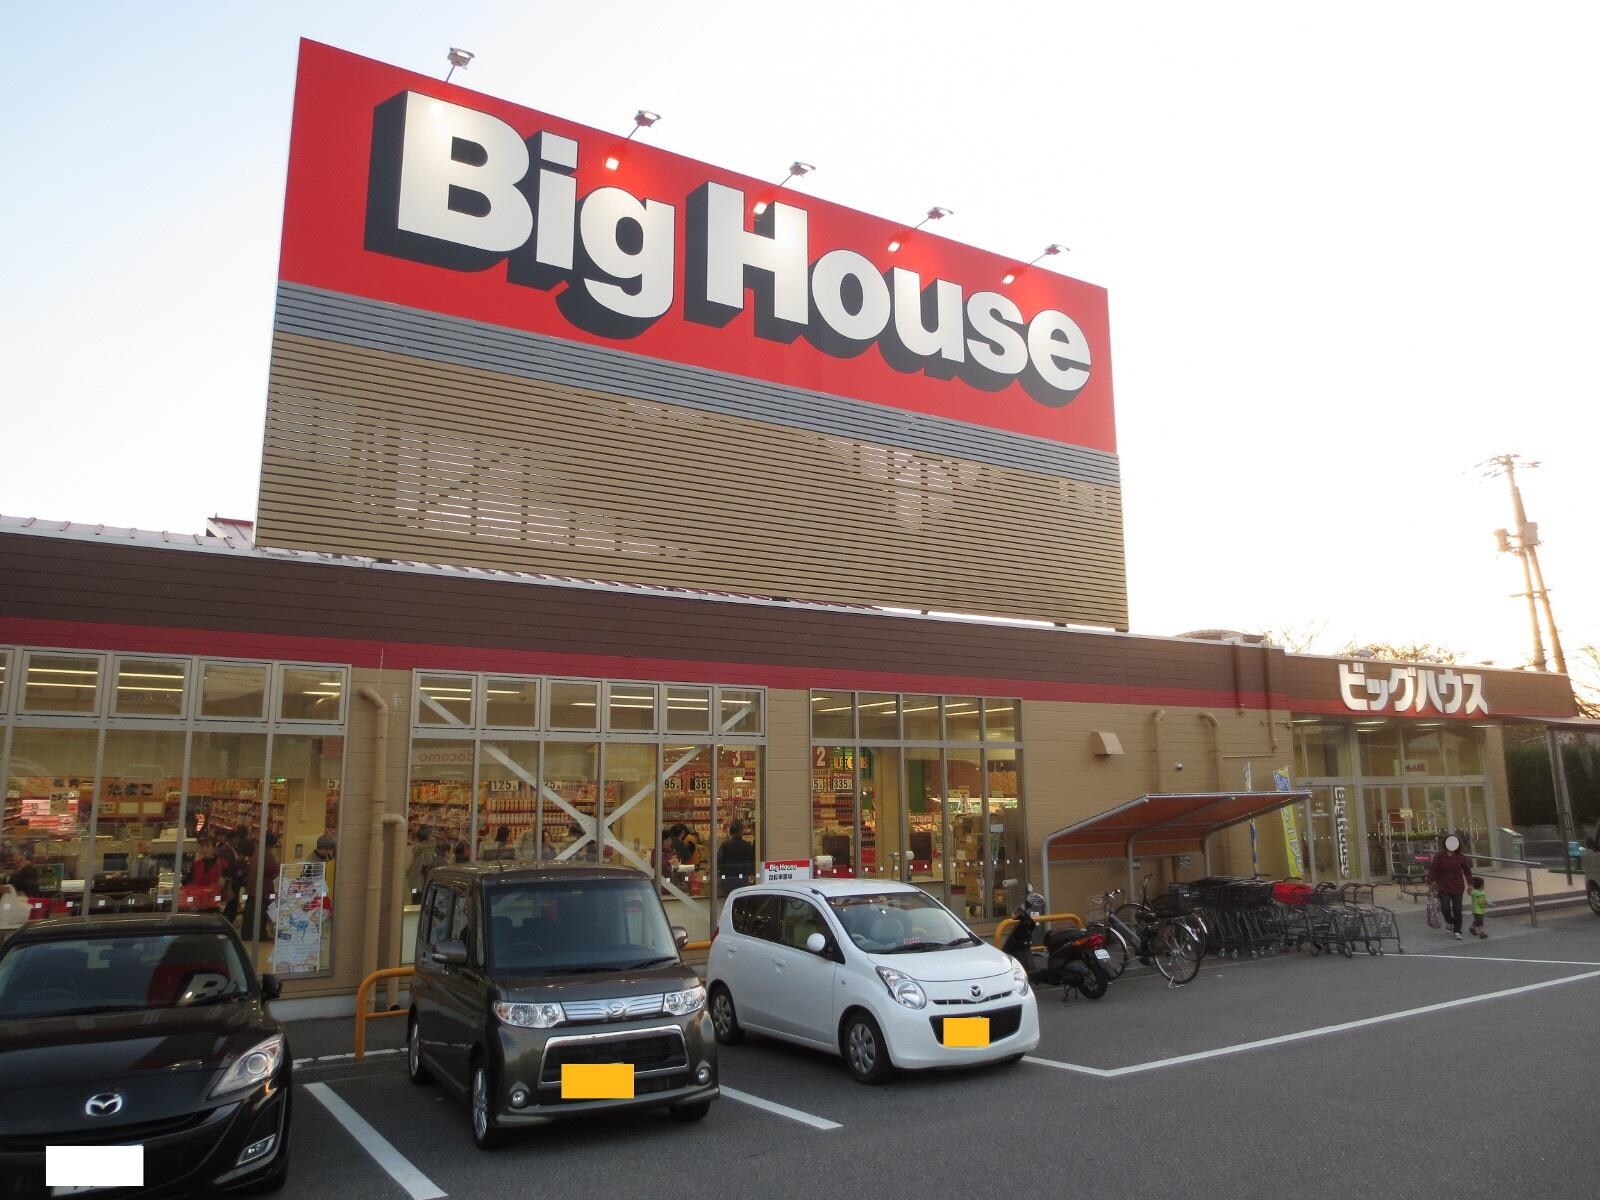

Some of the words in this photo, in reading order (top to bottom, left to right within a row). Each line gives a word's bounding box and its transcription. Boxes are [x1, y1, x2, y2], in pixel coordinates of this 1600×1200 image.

[396, 90, 676, 318] Big
[705, 180, 1092, 391] House
[1338, 662, 1489, 715] ビッグハウス
[732, 750, 741, 767] 3
[816, 746, 826, 767] 2
[694, 779, 712, 791] 365
[832, 779, 849, 790] 335
[1334, 786, 1347, 816] Big
[1336, 817, 1350, 878] House
[768, 864, 779, 873] Big
[779, 863, 798, 872] House
